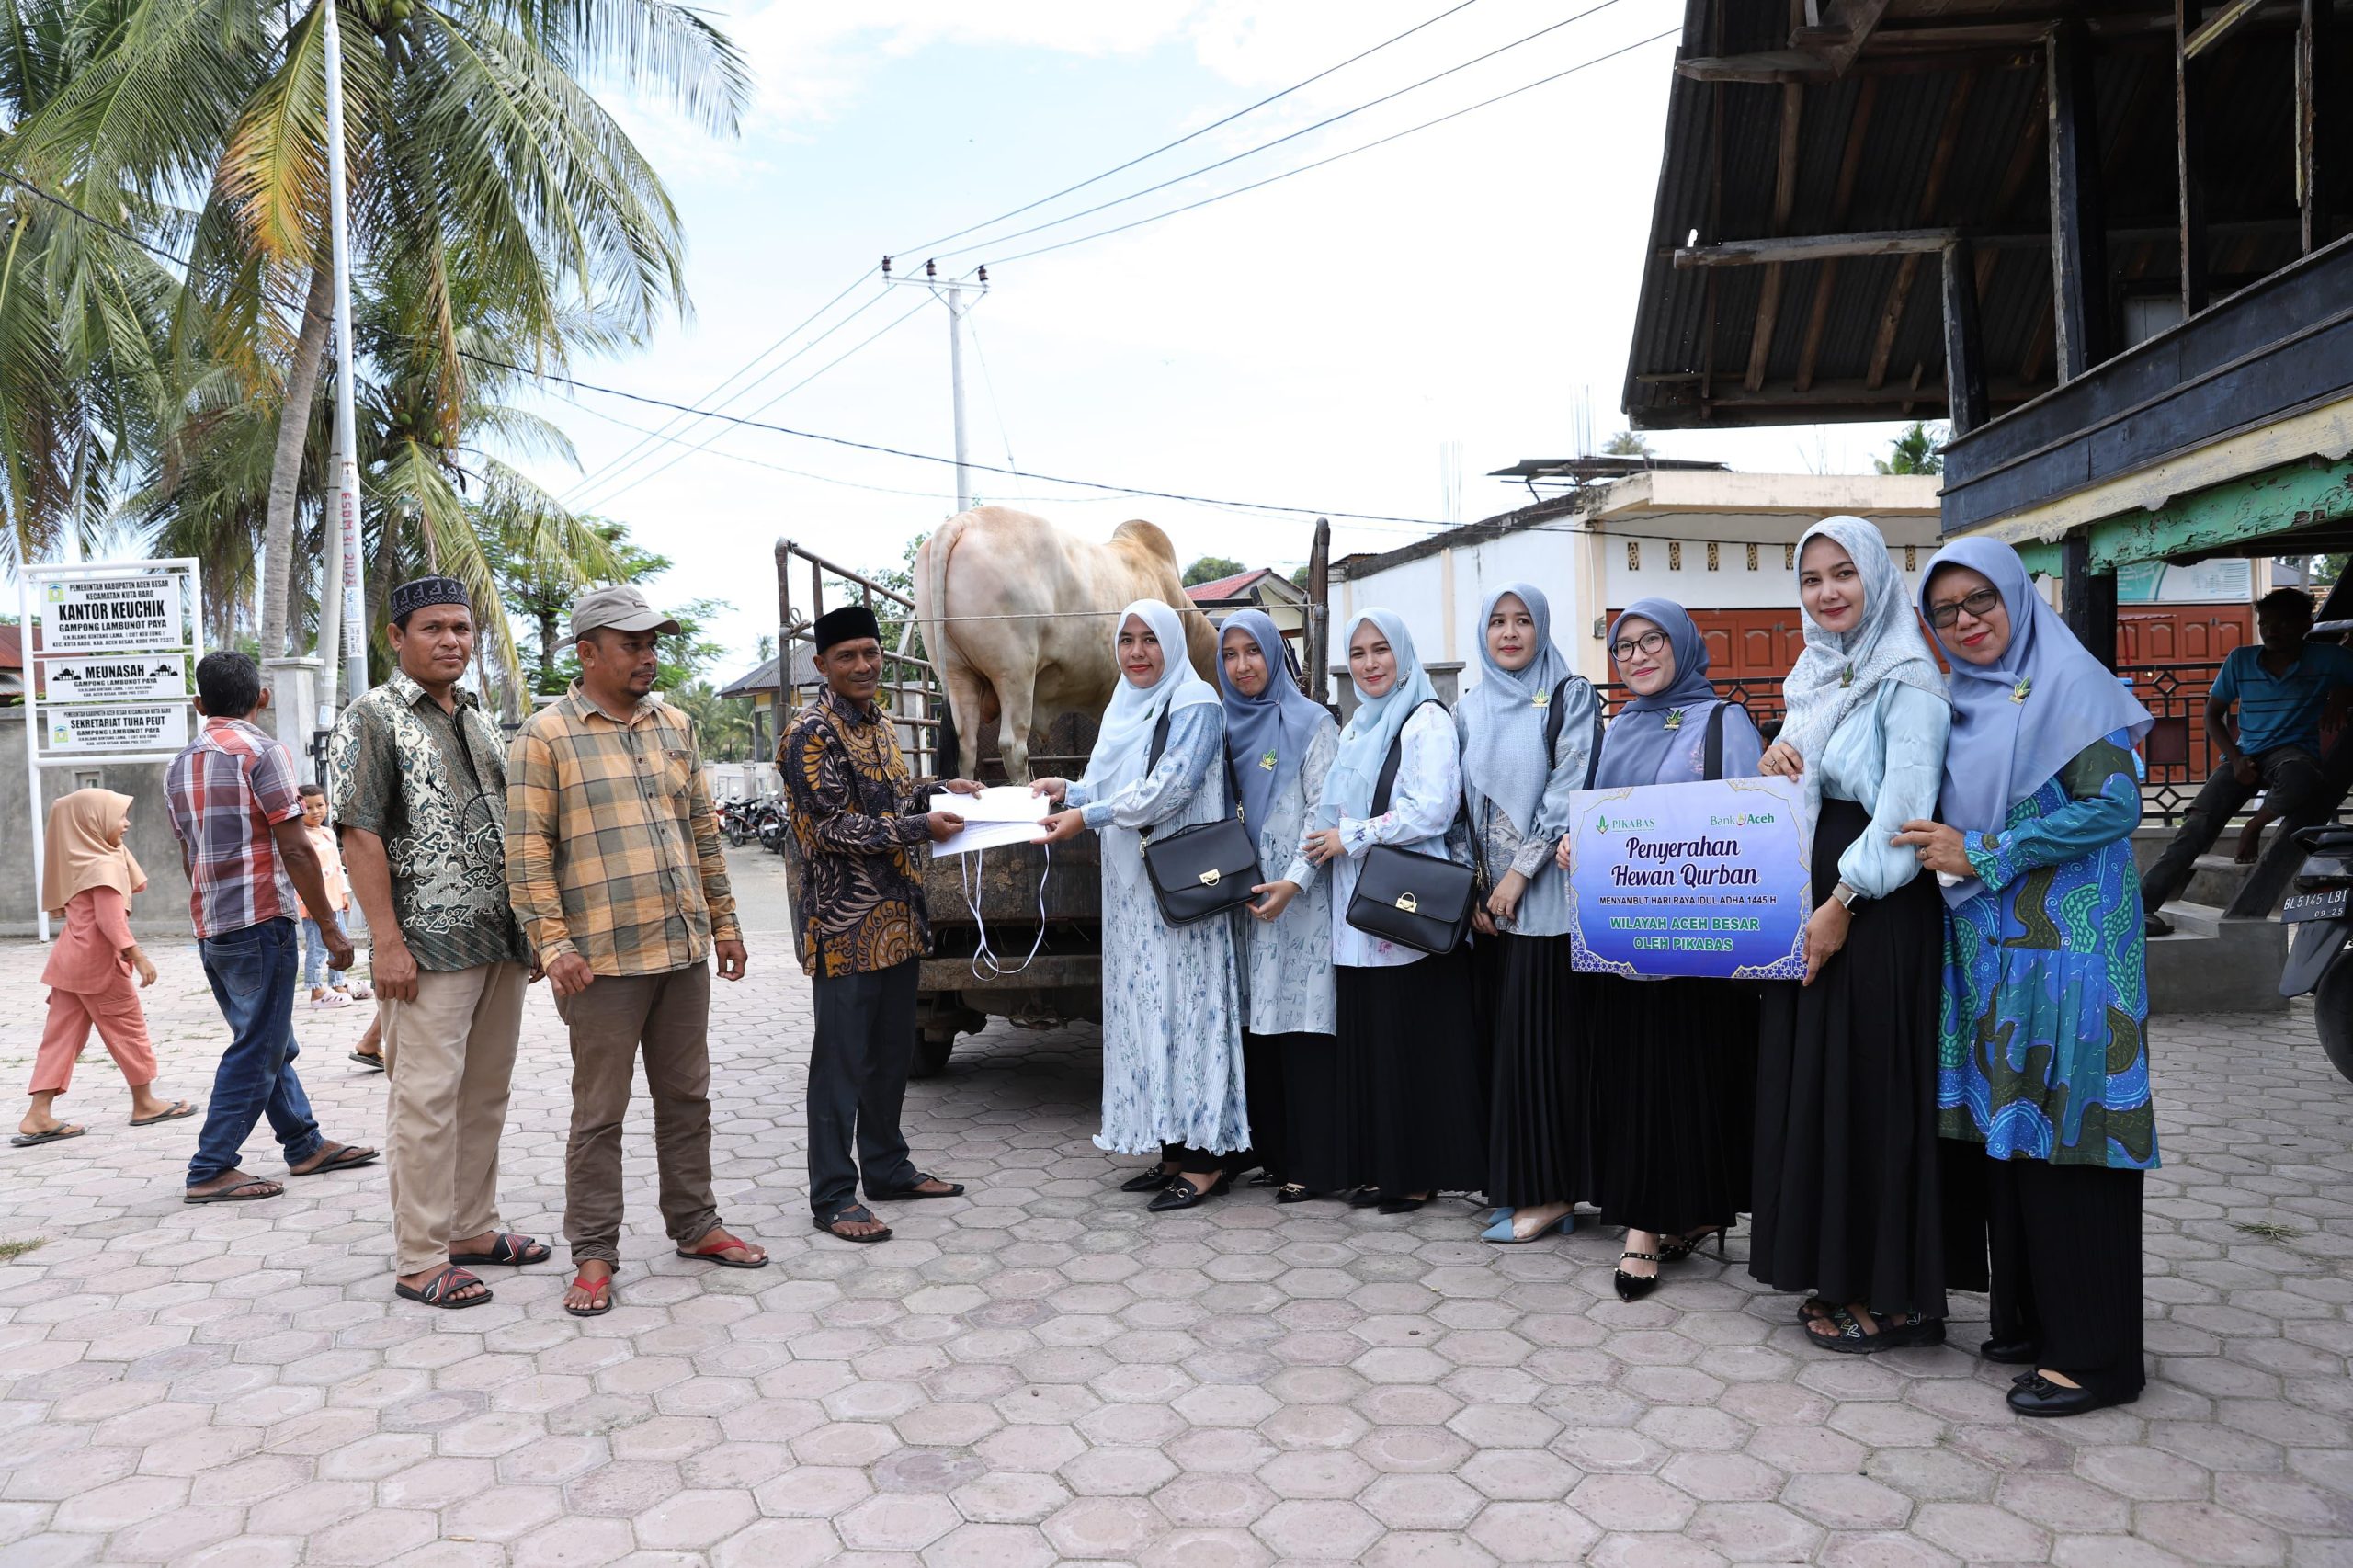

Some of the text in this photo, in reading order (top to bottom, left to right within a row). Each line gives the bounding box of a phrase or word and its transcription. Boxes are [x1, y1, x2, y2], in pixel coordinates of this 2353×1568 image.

[69, 579, 169, 592] PEMERINTAH KABUPATEN ACEH BESAR
[85, 591, 120, 600] KECAMATAN
[138, 589, 153, 598] BARO
[58, 600, 165, 621] KANTOR KEUCHIK
[59, 619, 167, 632] GAMPONG LAMBUNOT PAYA
[85, 665, 144, 679] MEUNASAH
[70, 715, 165, 730] SEKRETARIAT TUHA PEUT
[1612, 818, 1655, 829] PIKABAS
[1711, 813, 1775, 826] Bank Aceh
[1625, 835, 1741, 864] Penyerahan
[1611, 863, 1760, 889] Hewan Qurban
[1599, 895, 1777, 905] MENYAMBUT HARI RAYA IDUL ADHA 1445 H
[2283, 898, 2295, 910] BL
[2297, 894, 2323, 908] 5145
[2314, 907, 2344, 918] 09 25
[1610, 917, 1760, 931] WILAYAH ACEH BESAR
[1633, 937, 1733, 951] OLEH PIKABAS
